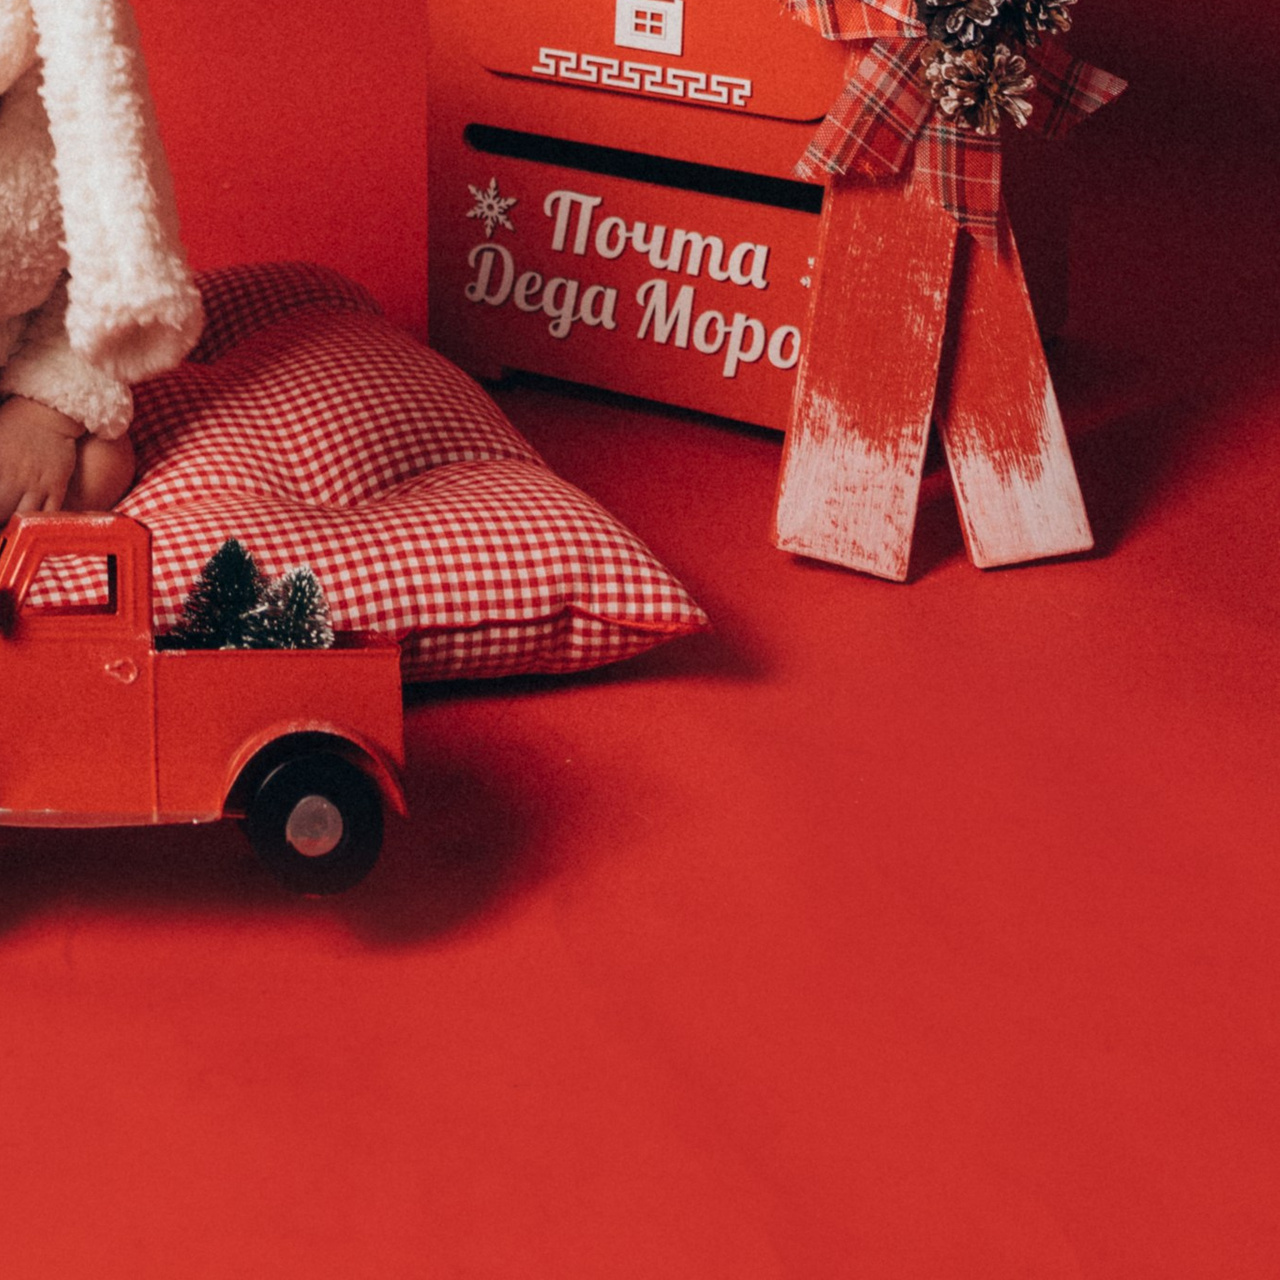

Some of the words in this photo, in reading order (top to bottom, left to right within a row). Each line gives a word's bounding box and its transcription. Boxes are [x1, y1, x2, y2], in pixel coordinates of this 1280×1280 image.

[542, 189, 769, 289] Почта
[464, 243, 617, 338] Деда
[635, 278, 801, 378] Моро
